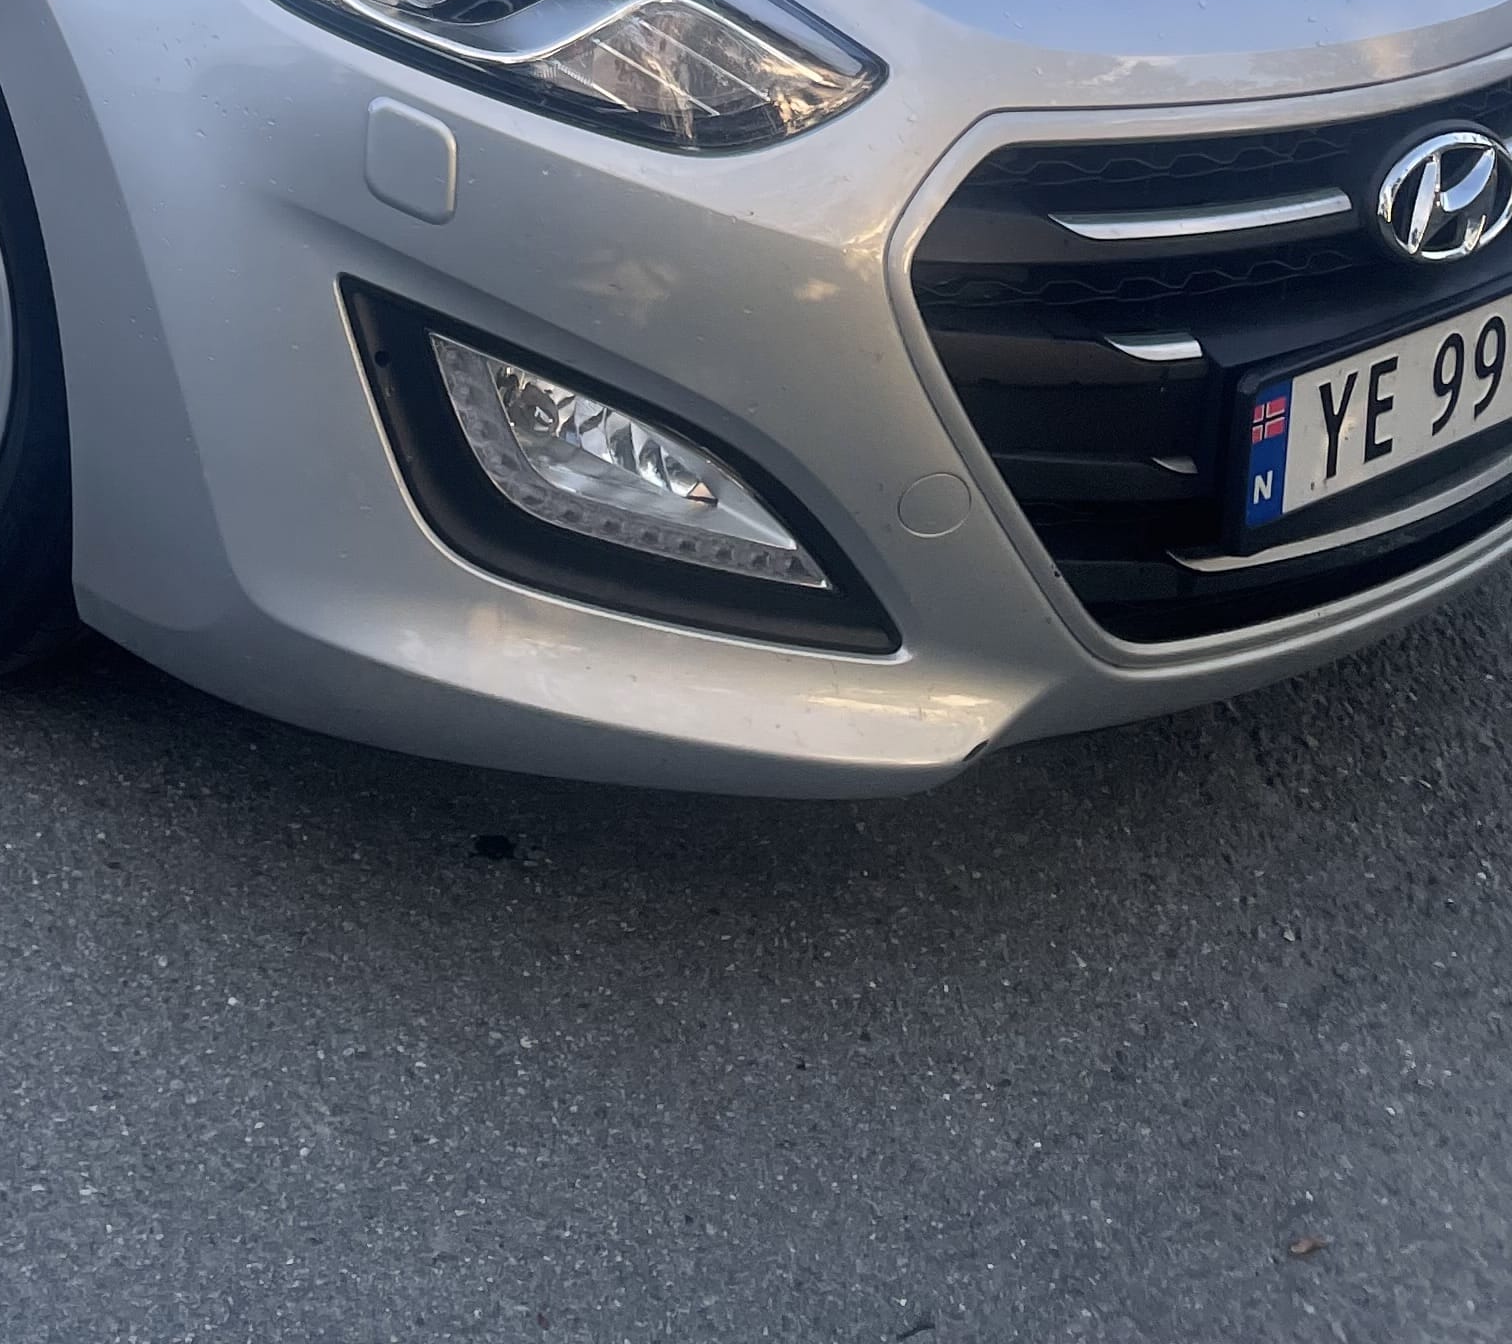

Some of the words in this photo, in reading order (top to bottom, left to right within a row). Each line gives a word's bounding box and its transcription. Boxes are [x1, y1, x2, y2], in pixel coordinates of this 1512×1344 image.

[1319, 356, 1399, 480] YE
[1431, 315, 1507, 436] 99
[1253, 470, 1273, 504] N
